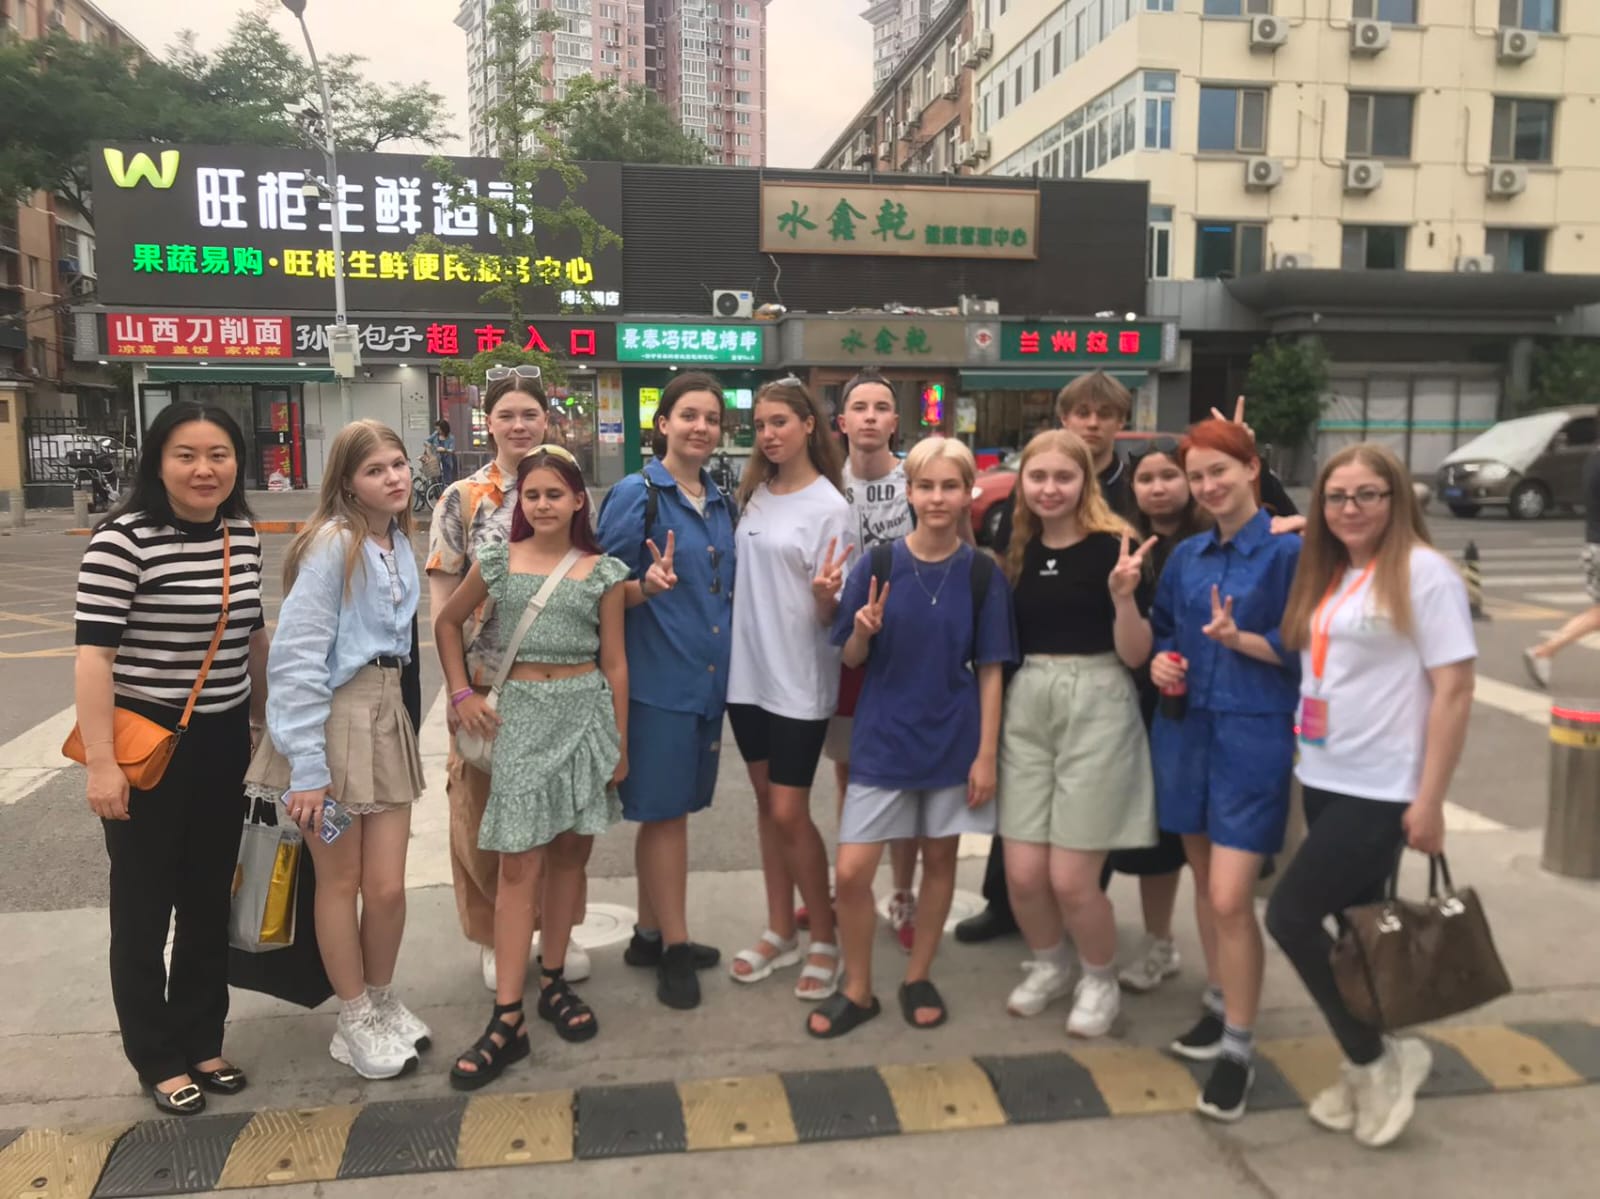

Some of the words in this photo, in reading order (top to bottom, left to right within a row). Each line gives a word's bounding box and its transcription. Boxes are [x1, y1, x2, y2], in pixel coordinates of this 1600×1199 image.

[777, 198, 916, 242] 水鑫乾
[115, 315, 283, 345] 山西刀削面
[296, 323, 424, 352] 孙包子
[426, 322, 597, 356] 超市入口
[1019, 330, 1141, 354] 兰州拉面
[866, 484, 896, 503] OLD
